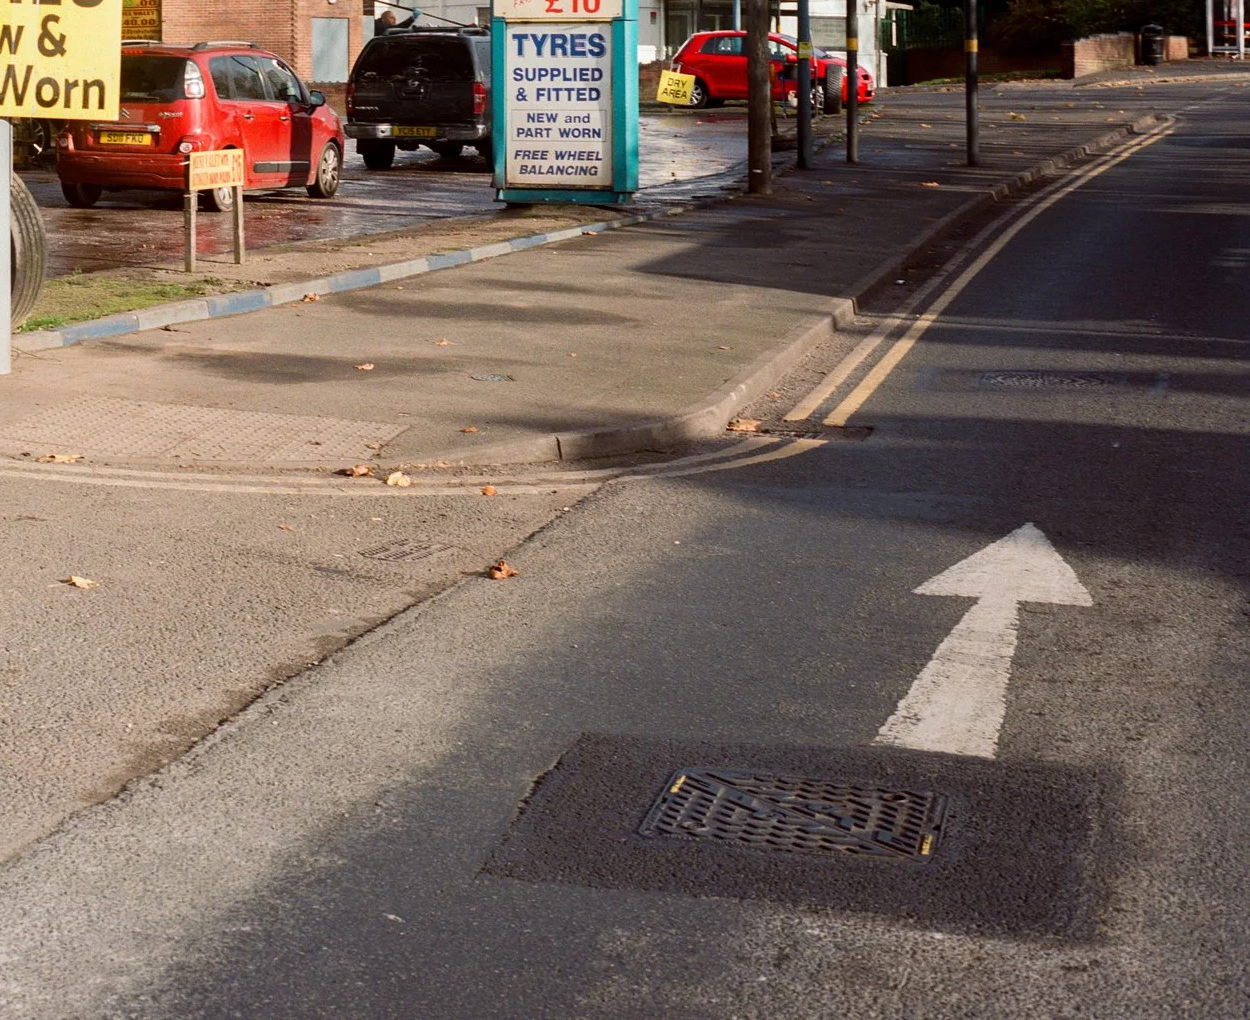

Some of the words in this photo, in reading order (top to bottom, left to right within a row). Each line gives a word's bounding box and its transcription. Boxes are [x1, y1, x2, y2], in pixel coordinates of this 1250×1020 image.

[37, 13, 67, 58] &
[512, 33, 607, 58] TYRES
[513, 67, 603, 82] SUPPLIED
[667, 77, 688, 89] DRY
[515, 87, 528, 102] &
[536, 87, 601, 101] FITTED
[662, 87, 688, 99] AREA
[526, 113, 558, 123] NEW
[564, 113, 590, 124] and
[516, 128, 552, 138] PART
[558, 128, 601, 139] WORN
[514, 150, 549, 160] FREE
[554, 150, 603, 161] WHEEL
[519, 164, 599, 176] BALANCING
